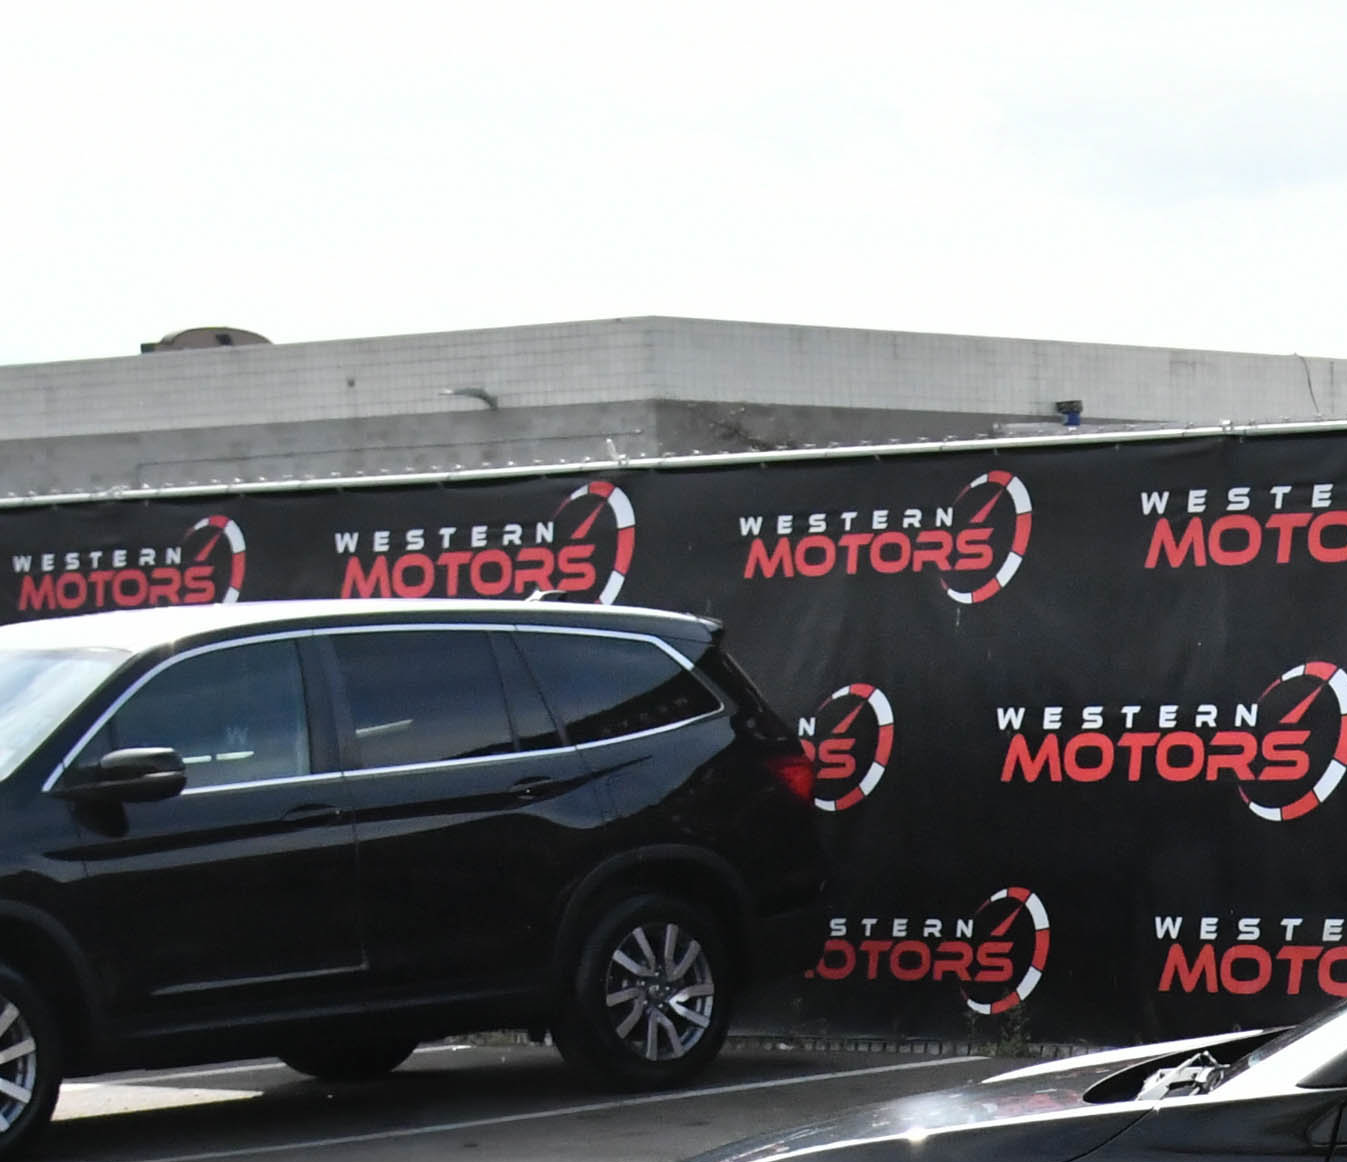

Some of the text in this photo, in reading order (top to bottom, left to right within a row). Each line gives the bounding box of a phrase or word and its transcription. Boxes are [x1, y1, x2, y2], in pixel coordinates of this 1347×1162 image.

[334, 521, 554, 554] WESTERN
[739, 506, 954, 537] WESTERN
[13, 546, 182, 573] WESTERN
[340, 543, 597, 600] MOTORS
[743, 527, 994, 580] MOTORS
[18, 565, 216, 611] MOTORS
[996, 703, 1259, 731] WESTERN
[1000, 729, 1311, 783] MOTORS
[830, 918, 974, 938] STERN
[816, 939, 1014, 982] OTORS
